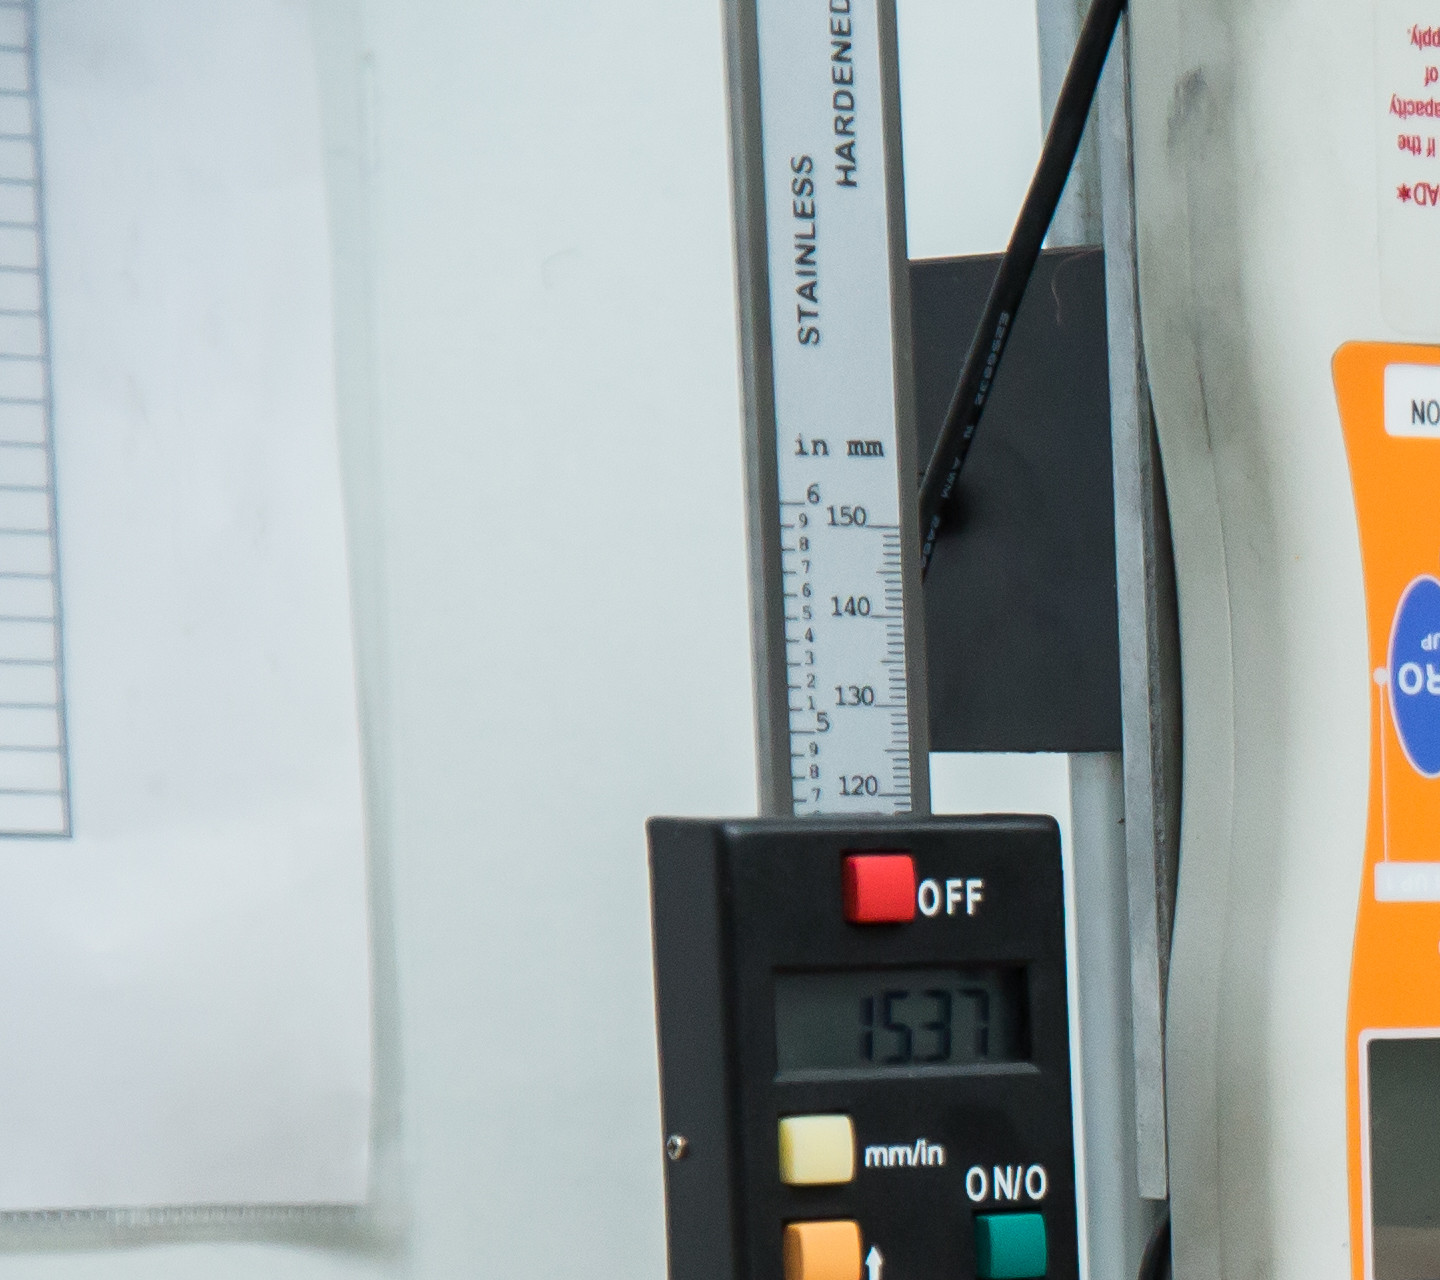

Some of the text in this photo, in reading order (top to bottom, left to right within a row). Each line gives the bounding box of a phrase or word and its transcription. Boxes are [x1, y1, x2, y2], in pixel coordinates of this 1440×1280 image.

[1424, 66, 1438, 87] of
[829, 0, 857, 187] HARDENED
[1398, 134, 1422, 156] the
[1426, 136, 1435, 158] if
[791, 153, 820, 345] STAINLESS
[795, 433, 884, 457] in mm
[807, 483, 820, 504] 6
[799, 513, 808, 528] 9
[827, 505, 867, 526] 150
[799, 536, 809, 551] 8
[802, 560, 810, 574] 7
[802, 583, 811, 598] 6
[802, 605, 812, 620] 5
[831, 596, 870, 616] 140
[804, 627, 814, 642] 4
[805, 651, 814, 665] 3
[806, 673, 815, 688] 2
[808, 696, 815, 710] 1
[834, 686, 874, 706] 130
[816, 712, 830, 732] 5
[809, 742, 818, 757] 9
[810, 764, 819, 779] 8
[812, 788, 821, 802] 7
[838, 775, 878, 797] 120
[918, 878, 985, 916] OFF
[864, 1138, 945, 1167] mm/in
[966, 1165, 1048, 1201] ON/O
